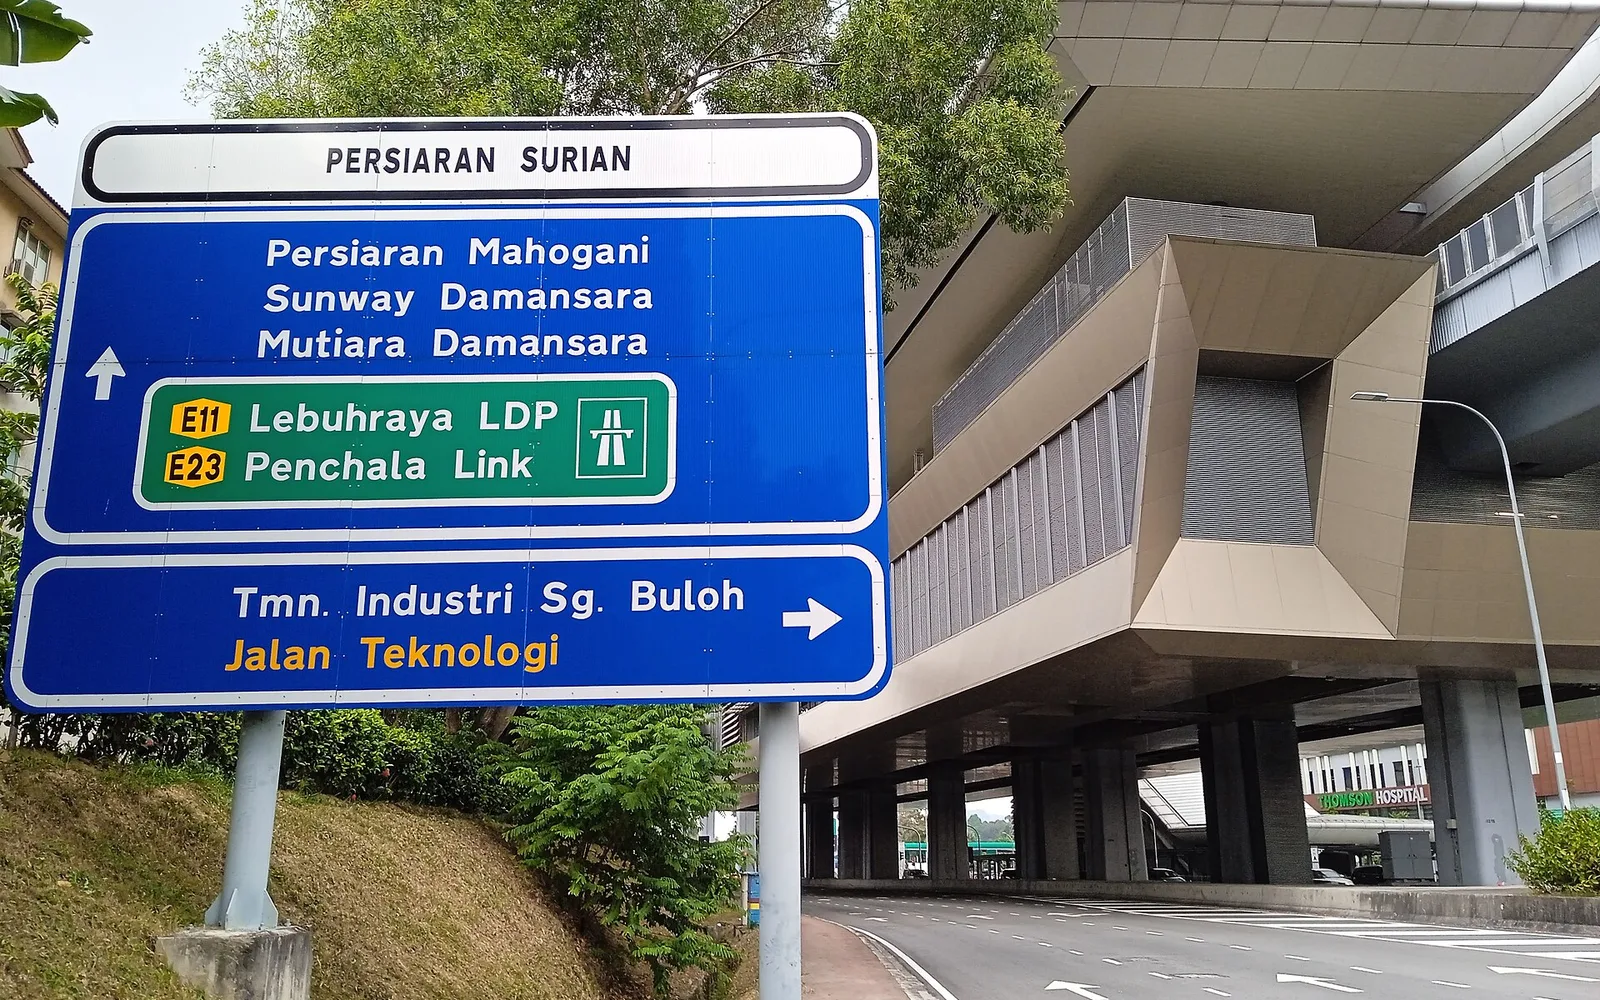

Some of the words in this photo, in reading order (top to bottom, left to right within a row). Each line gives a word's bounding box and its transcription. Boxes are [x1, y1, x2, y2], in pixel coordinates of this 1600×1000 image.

[327, 147, 494, 173] PERSIARAN
[521, 146, 630, 172] SURIAN
[267, 239, 442, 266] Persiaran
[469, 236, 648, 269] Mahogani
[264, 285, 414, 316] Sunway
[441, 283, 652, 310] Damansara
[258, 328, 405, 358] Mutiara
[434, 329, 647, 356] Damansara
[182, 406, 219, 432] E11
[250, 403, 452, 437] Lebuhraya
[480, 401, 557, 429] LDP
[169, 453, 221, 480] E23
[245, 451, 425, 480] Penchala
[455, 449, 533, 478] Link
[234, 588, 328, 617] Tmn.
[357, 583, 512, 616] Industri
[541, 582, 602, 619] Sg.
[632, 580, 743, 611] Buloh
[225, 639, 329, 671] Jalan
[361, 634, 558, 672] Teknologi
[1319, 791, 1373, 809] THOMSON
[1376, 785, 1428, 805] HOSPITAL
